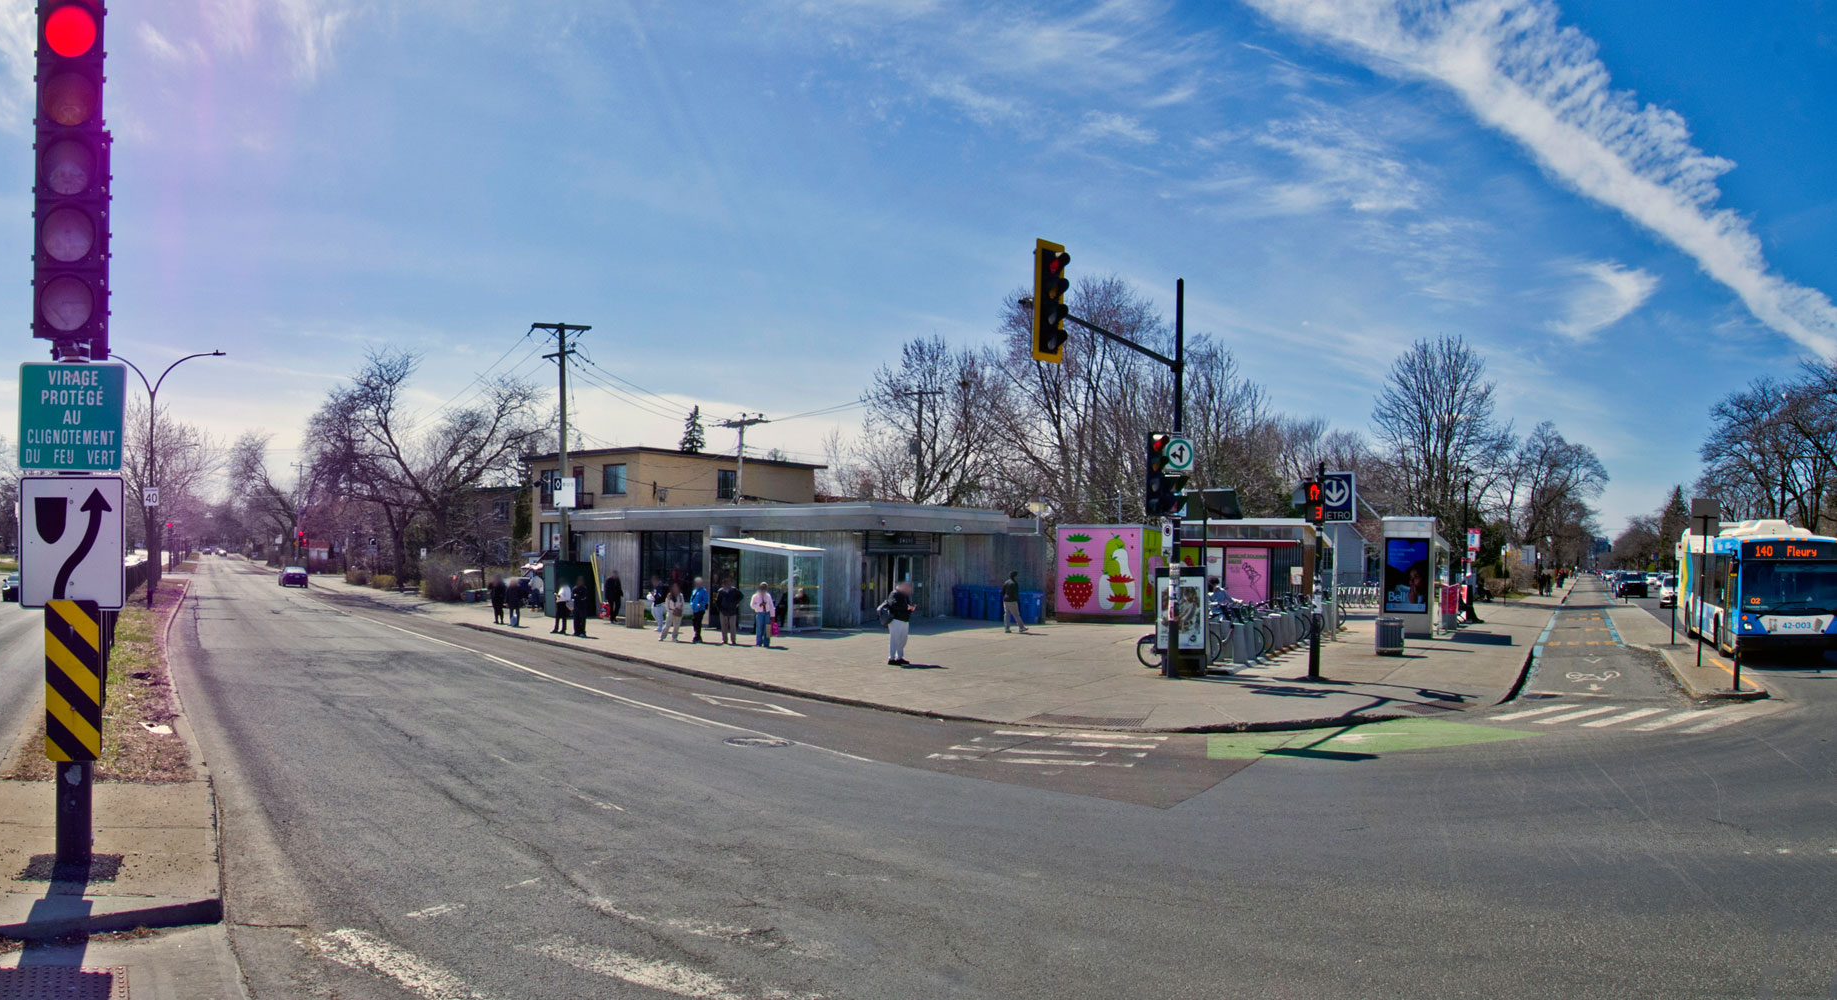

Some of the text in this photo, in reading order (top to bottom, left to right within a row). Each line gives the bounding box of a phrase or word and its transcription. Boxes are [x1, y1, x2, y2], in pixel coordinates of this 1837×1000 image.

[48, 370, 98, 386] VIRAGE
[41, 386, 103, 406] PROTÉGÉ
[62, 409, 81, 425] AU
[27, 429, 115, 445] CLIGNOTEMENT
[25, 448, 116, 465] DU FEU VERT
[146, 493, 157, 503] 40
[1325, 511, 1351, 520] ETRO
[1755, 545, 1817, 557] 140 Fleury
[1388, 591, 1406, 602] Bell
[1782, 621, 1811, 629] 42-003
